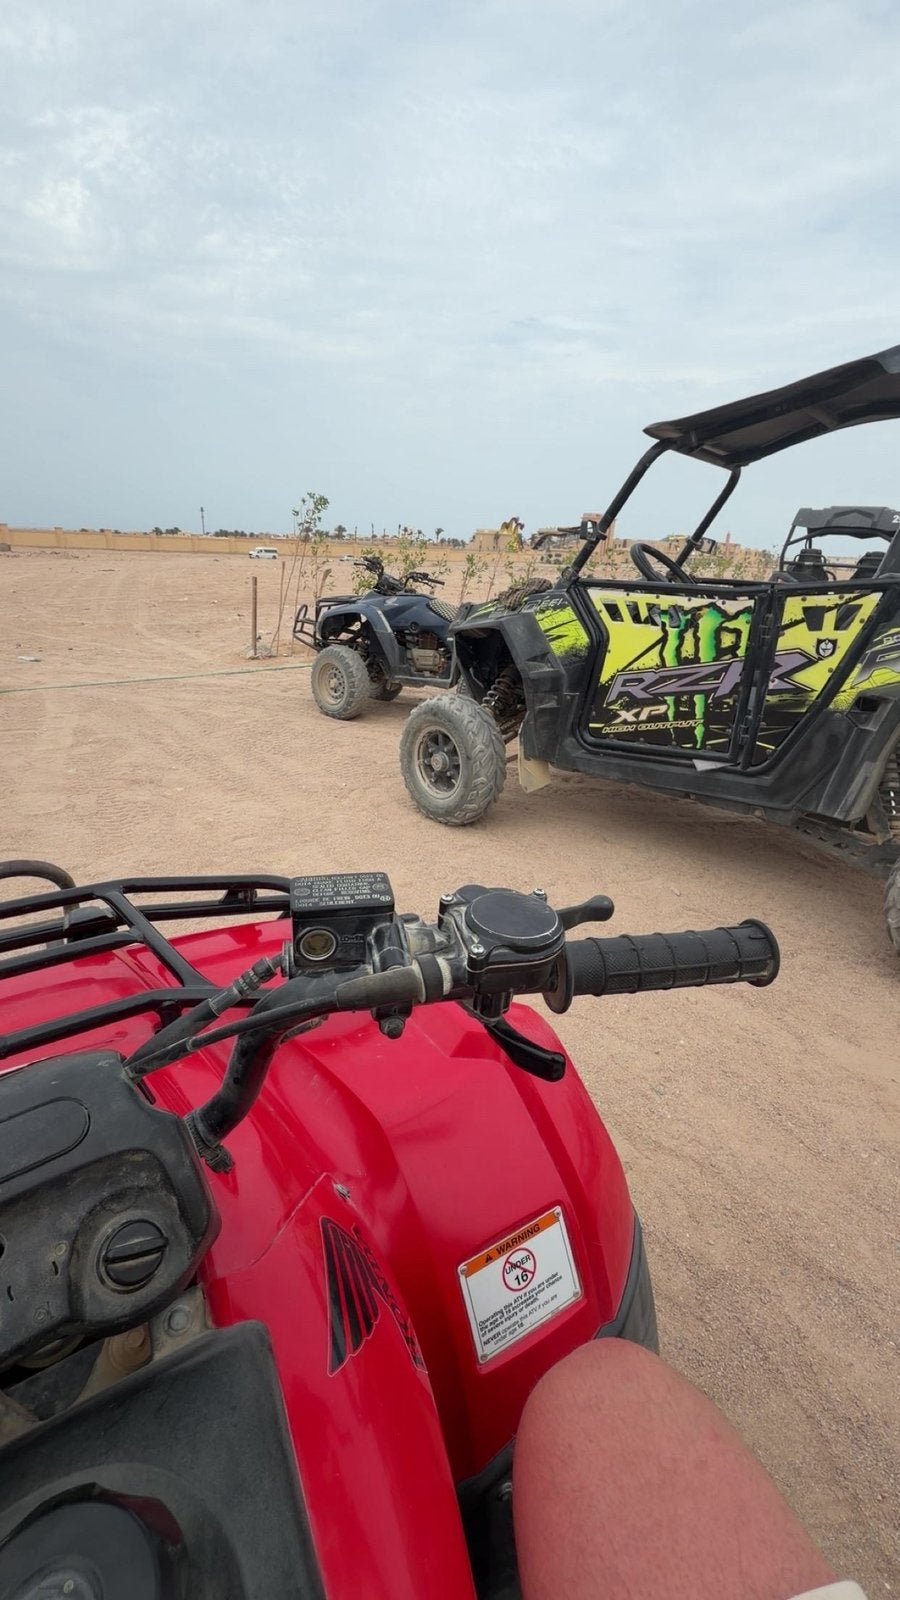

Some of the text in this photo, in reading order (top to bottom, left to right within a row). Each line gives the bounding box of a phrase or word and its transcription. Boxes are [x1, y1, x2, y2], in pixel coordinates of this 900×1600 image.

[611, 704, 668, 724] XP
[495, 1223, 540, 1255] WARNING
[505, 1253, 530, 1275] UNDER
[514, 1270, 529, 1287] 16
[478, 1307, 503, 1330] Operating
[513, 1294, 522, 1304] ATV
[483, 1330, 501, 1346] NEVER
